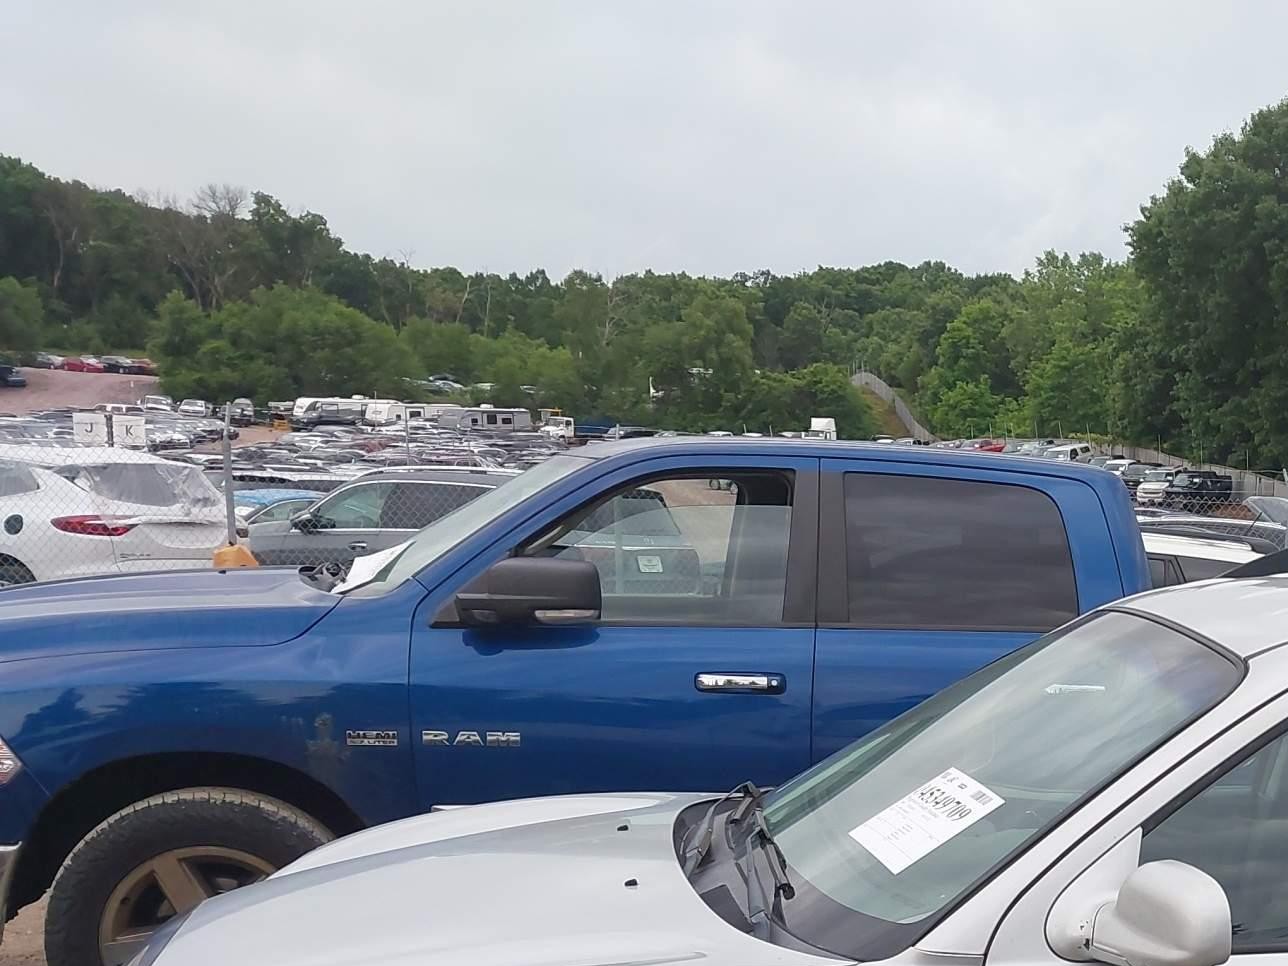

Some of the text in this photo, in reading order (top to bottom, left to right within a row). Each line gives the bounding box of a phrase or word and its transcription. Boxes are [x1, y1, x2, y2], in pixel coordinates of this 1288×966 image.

[84, 422, 94, 433] J
[125, 424, 135, 437] K
[347, 731, 398, 741] HEMI
[422, 730, 521, 747] RAM
[917, 785, 973, 822] 45349709
